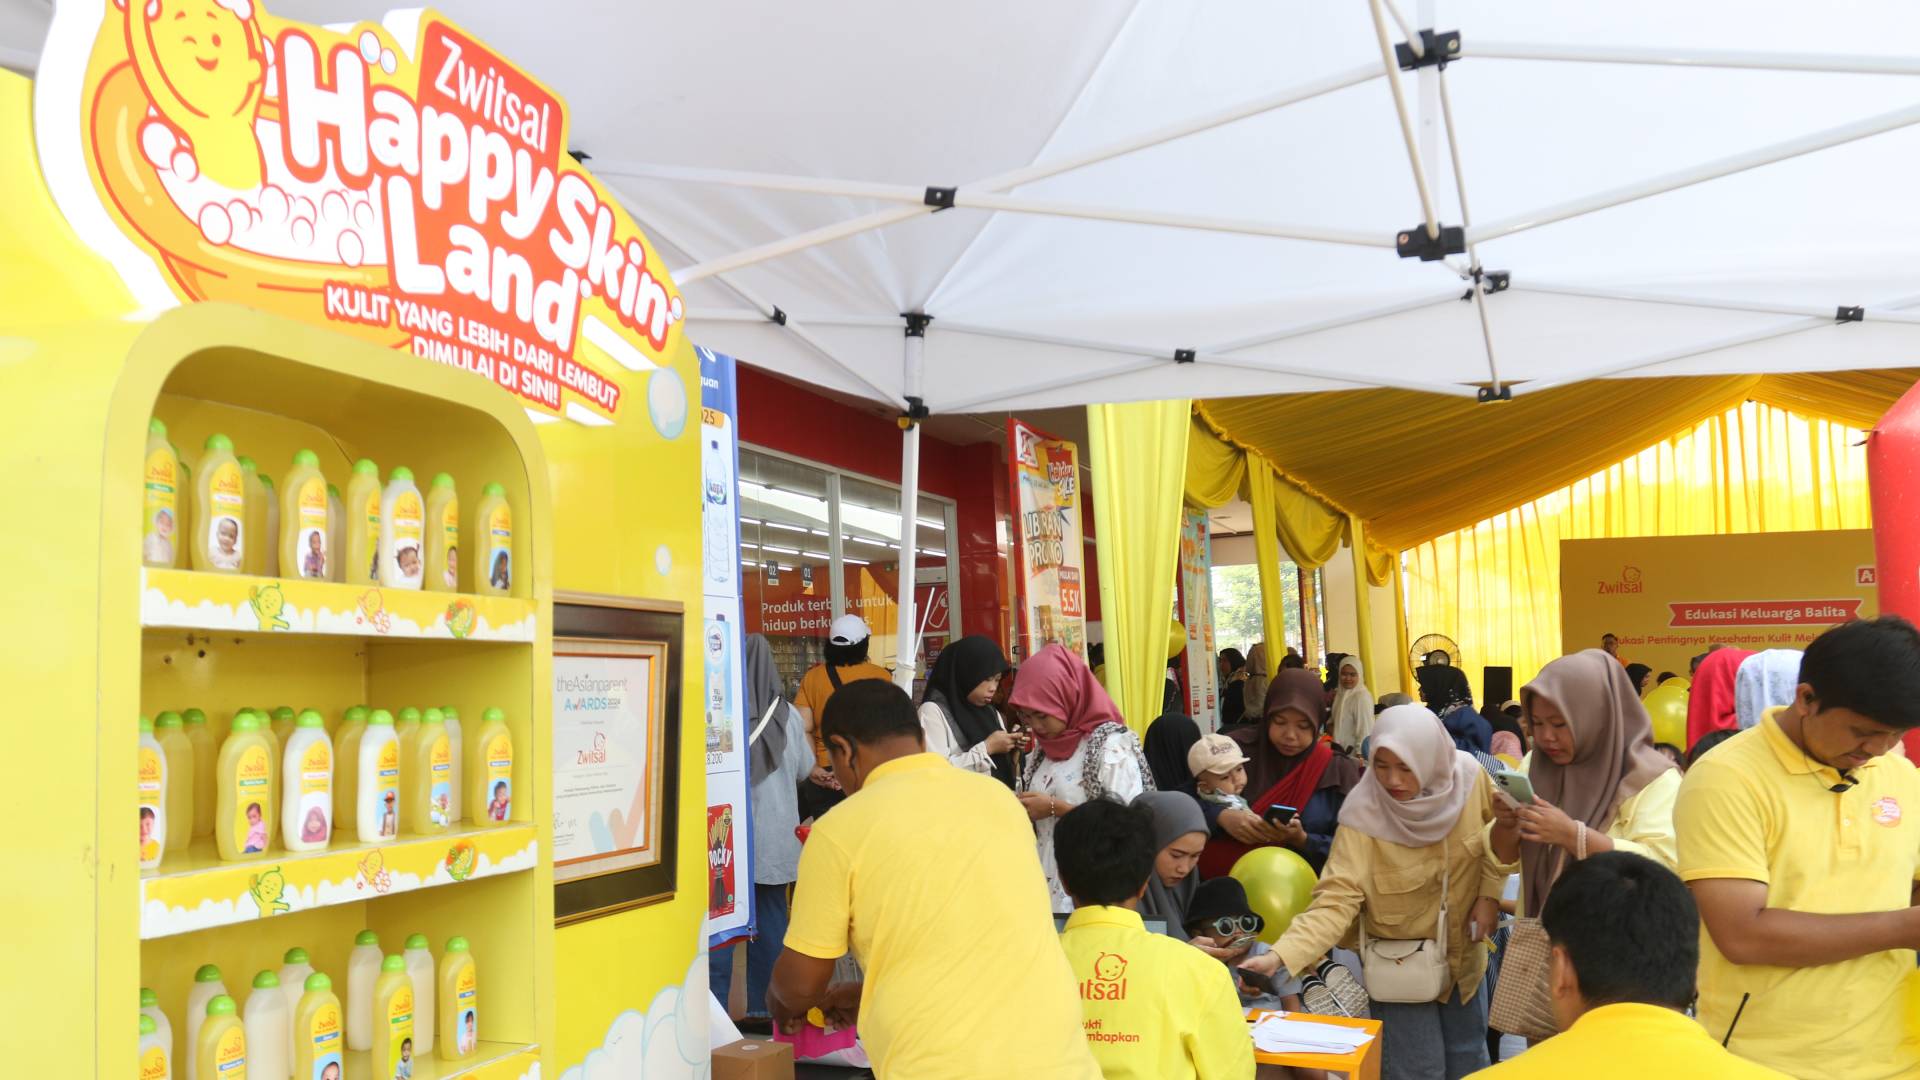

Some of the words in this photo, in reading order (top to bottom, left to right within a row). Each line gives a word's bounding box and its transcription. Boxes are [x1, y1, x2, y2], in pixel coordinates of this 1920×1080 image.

[435, 36, 549, 153] Zwitsal
[283, 33, 554, 240] Happy
[549, 174, 673, 341] Skin
[386, 175, 579, 351] Land
[326, 286, 391, 322] KULIT
[394, 299, 453, 335] YANG
[459, 317, 509, 356] LEBIH
[513, 339, 554, 374] DARI
[557, 359, 618, 409] LEMBUT
[413, 336, 494, 381] DIMULAI
[499, 362, 517, 390] DI
[521, 373, 559, 406] SINI!
[700, 375, 719, 390] uan
[701, 408, 715, 425] 25
[1023, 511, 1063, 541] LIBRAN
[1598, 580, 1642, 594] Zwitsal
[762, 600, 805, 614] Produk
[808, 596, 852, 612] terbk
[855, 594, 894, 608] untuk
[1062, 589, 1080, 613] 5.5K
[1684, 608, 1737, 620] Edukasi
[1741, 607, 1801, 620] Keluarga
[1805, 606, 1847, 618] Balita
[762, 619, 797, 633] hidup
[1617, 635, 1645, 646] ukasi
[1647, 634, 1706, 647] Pentingnya
[1709, 633, 1764, 645] Kesehatan
[1767, 632, 1792, 643] Kulit
[577, 749, 606, 766] Zwitsal
[708, 847, 733, 870] POCKY
[1080, 978, 1127, 1000] itsal
[1082, 1018, 1102, 1030] ukti
[1086, 1031, 1140, 1044] mbapkan
